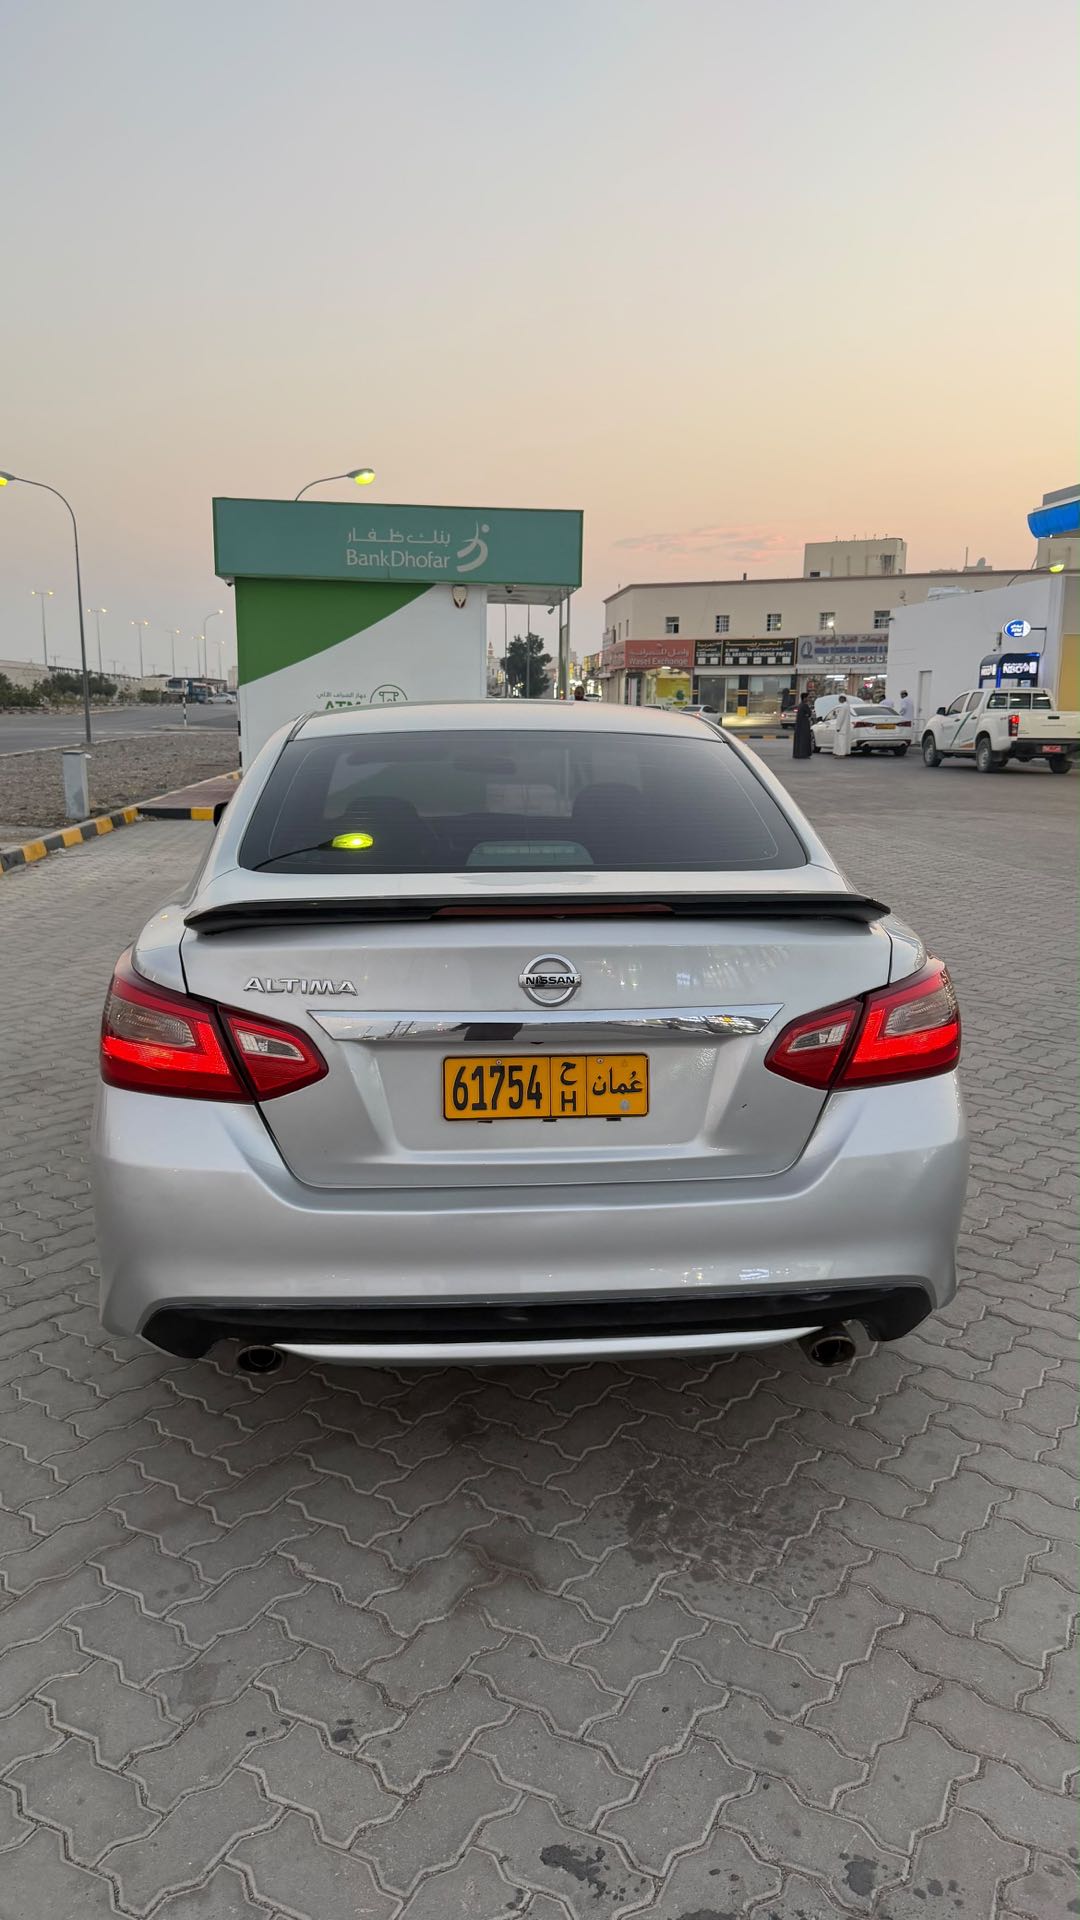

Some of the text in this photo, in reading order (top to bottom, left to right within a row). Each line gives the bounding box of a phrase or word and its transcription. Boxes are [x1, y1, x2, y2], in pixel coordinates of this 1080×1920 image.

[347, 527, 450, 547] بنك ظفار
[629, 657, 689, 667] Wasel Exchange
[243, 976, 358, 996] ALTIMA
[525, 976, 575, 985] NISSAN
[560, 1061, 577, 1085] ح
[452, 1065, 543, 1111] 61754
[560, 1090, 576, 1112] H
